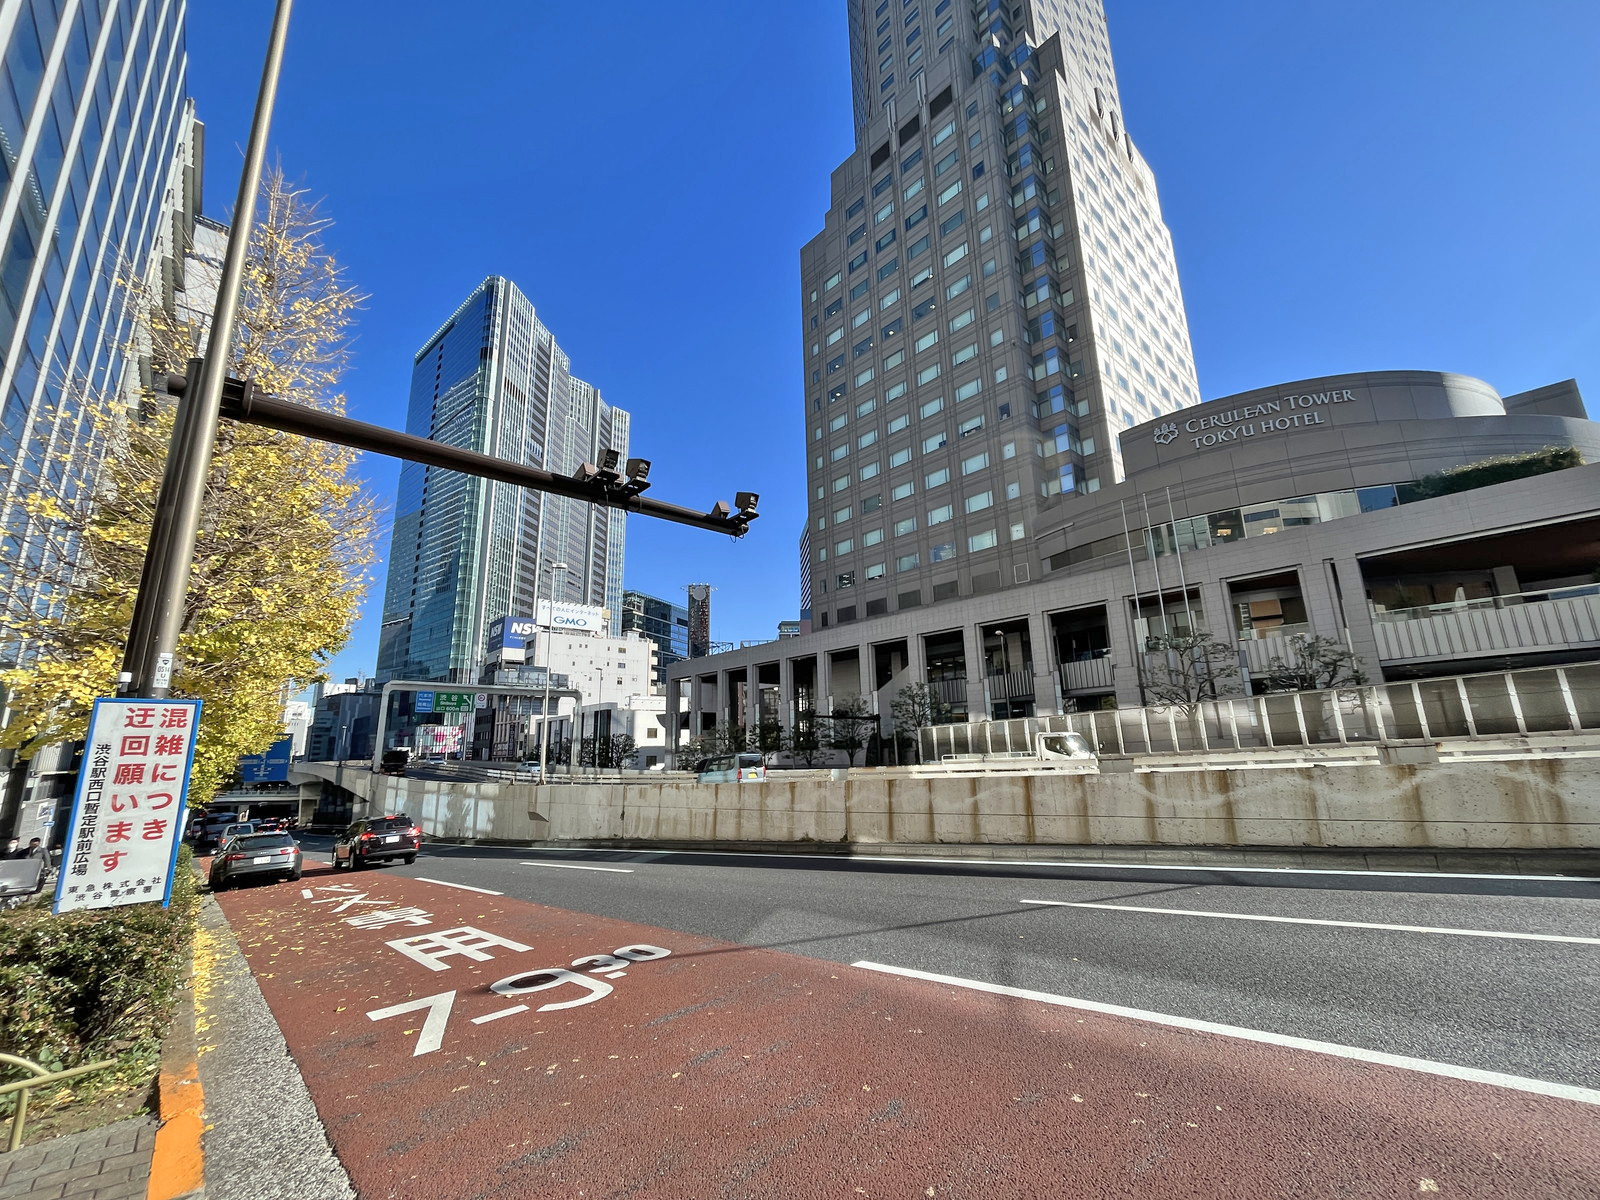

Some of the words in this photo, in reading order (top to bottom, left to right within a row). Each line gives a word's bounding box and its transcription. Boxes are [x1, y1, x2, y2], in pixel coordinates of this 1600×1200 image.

[1186, 402, 1281, 432] CERULEAN
[1284, 389, 1356, 409] TOWER
[1191, 424, 1255, 449] TOKYU
[1260, 412, 1324, 432] HOTEL
[553, 616, 587, 627] GMO
[100, 707, 156, 873] 迂回願います
[142, 707, 188, 841] 混雑につき
[70, 743, 112, 877] 渋谷駅西口暫定駅前広場
[67, 876, 162, 894] 東急株式会社
[75, 885, 153, 902] 渋谷警察署
